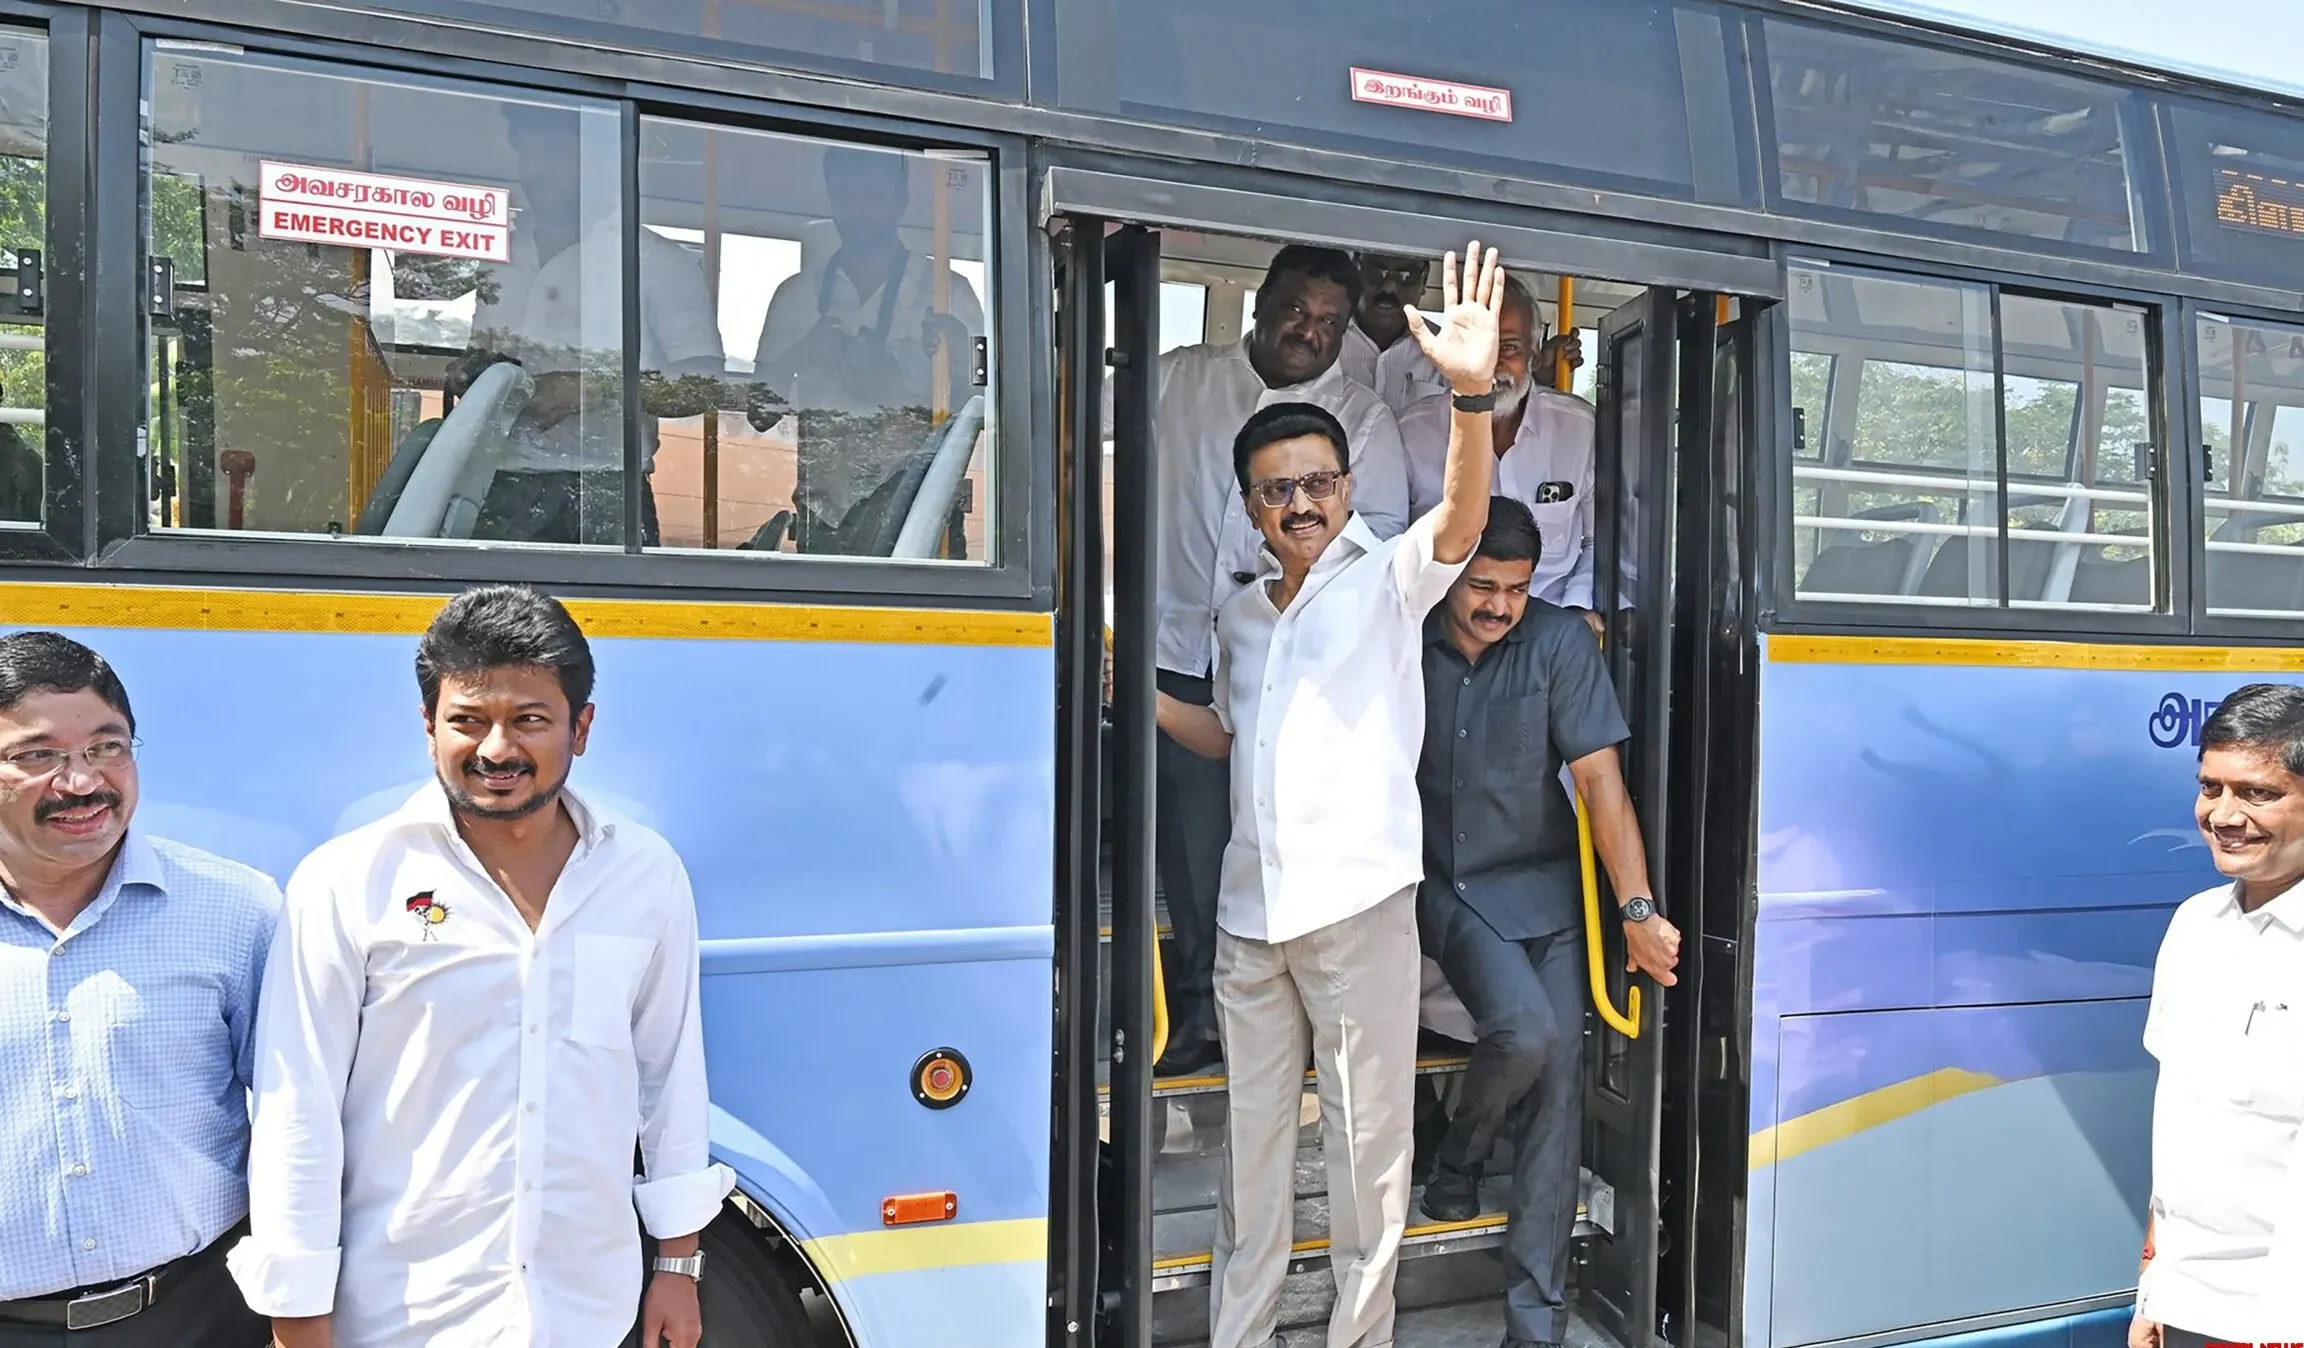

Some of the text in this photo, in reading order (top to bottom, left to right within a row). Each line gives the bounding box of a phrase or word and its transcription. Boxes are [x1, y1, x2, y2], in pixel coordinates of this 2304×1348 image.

[1363, 78, 1502, 114] இறங்கும் வழி
[274, 172, 496, 221] அவசரகால வழி
[273, 211, 496, 252] EMERGENCY EXIT
